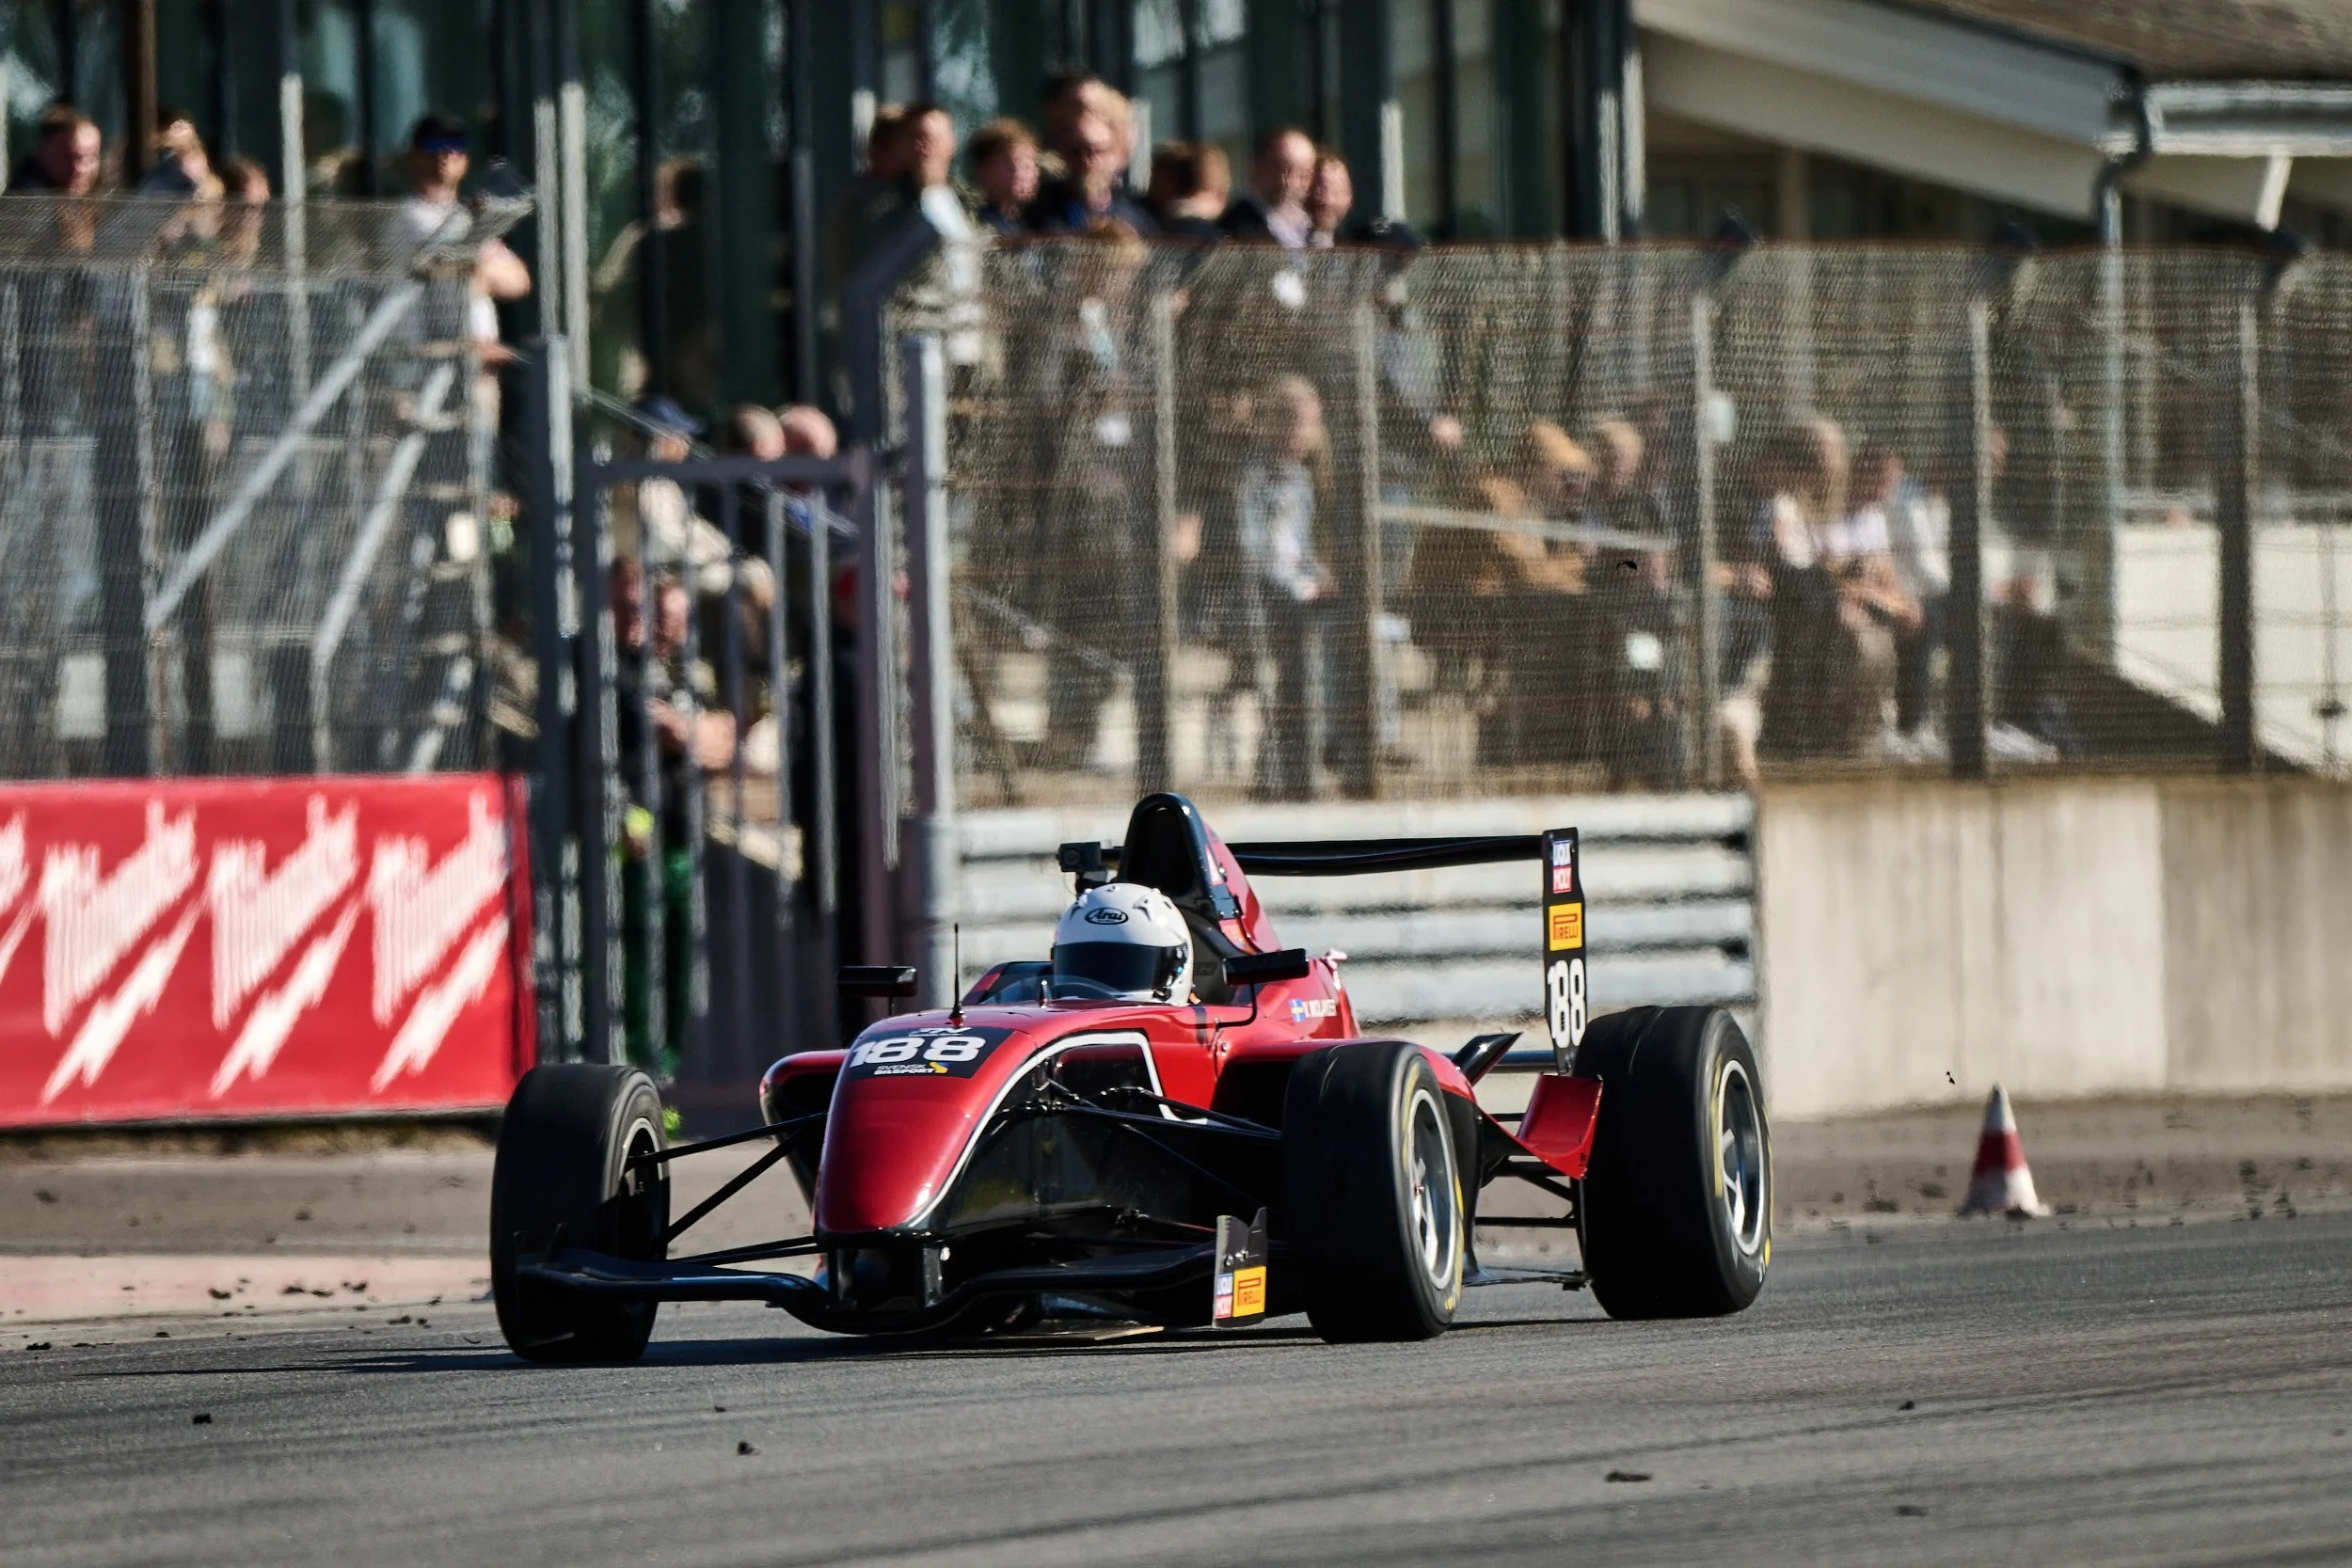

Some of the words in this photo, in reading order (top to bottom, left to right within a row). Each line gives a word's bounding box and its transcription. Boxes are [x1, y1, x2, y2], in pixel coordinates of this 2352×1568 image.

[1089, 909, 1124, 921] Arai
[1553, 912, 1579, 940] PIRELLI
[1548, 958, 1586, 1049] 188
[850, 1036, 987, 1068] 188
